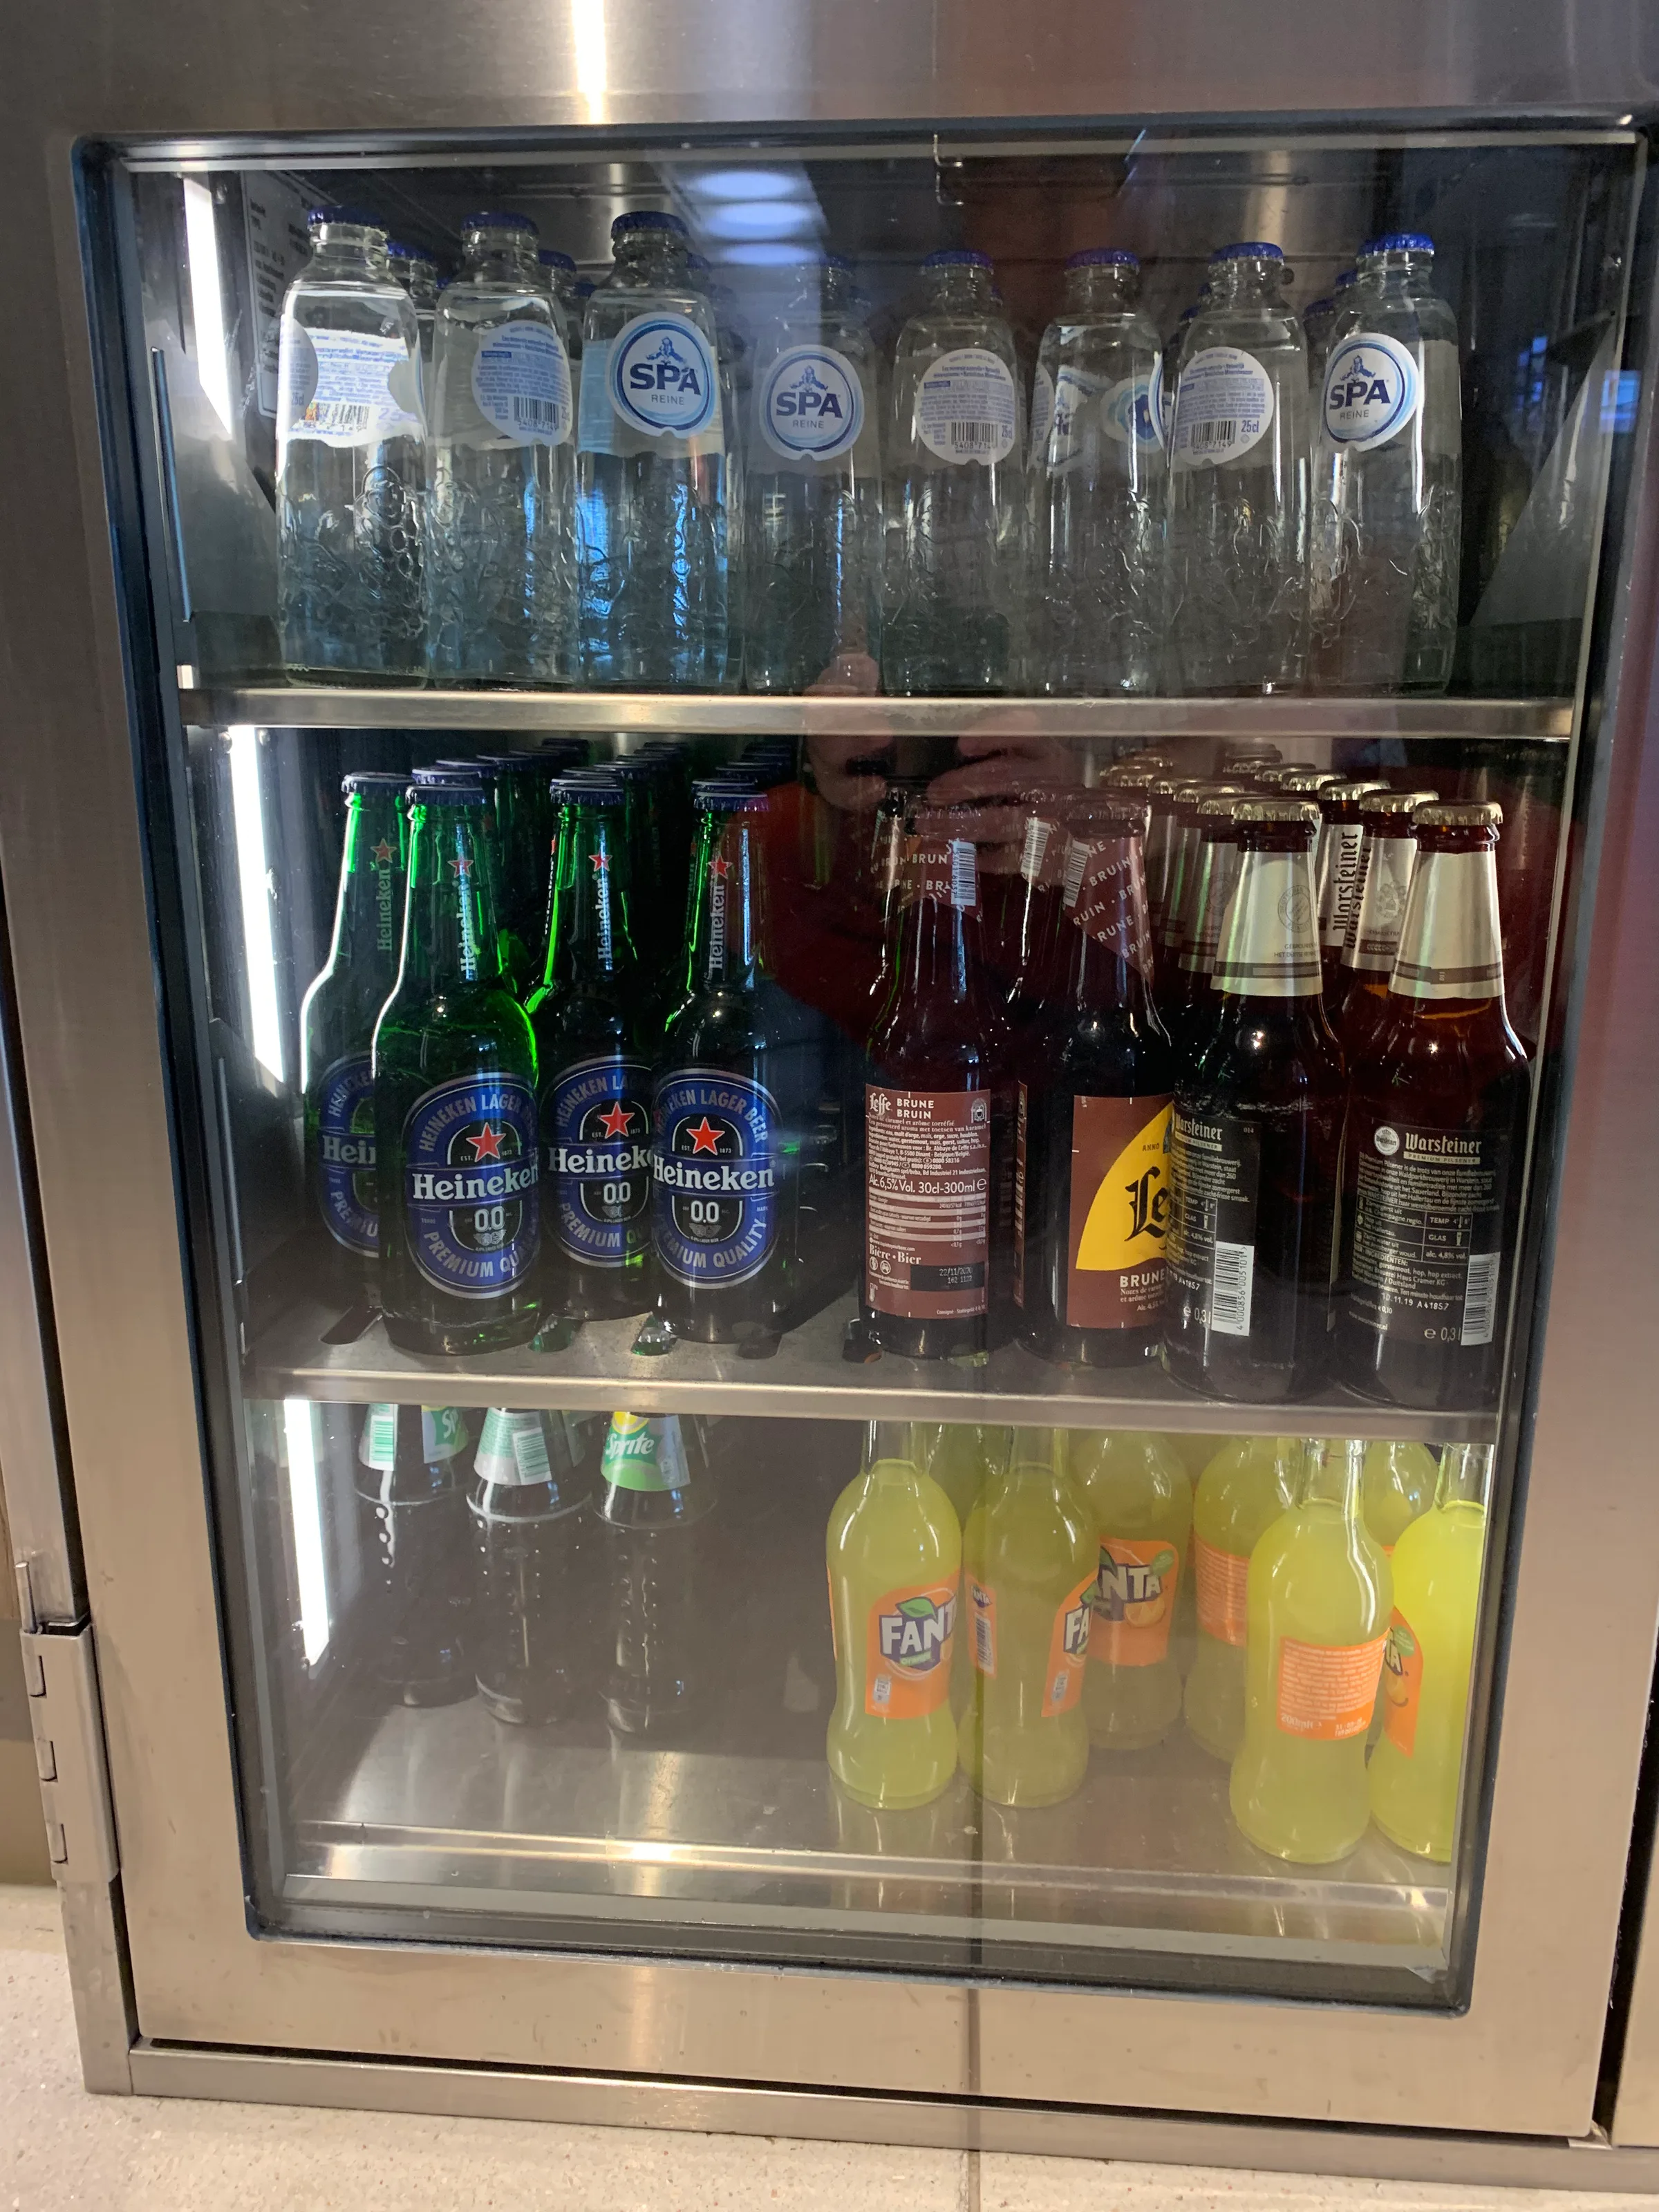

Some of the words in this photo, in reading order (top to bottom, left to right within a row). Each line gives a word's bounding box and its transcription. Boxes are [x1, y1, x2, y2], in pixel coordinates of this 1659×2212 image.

[630, 362, 702, 396] SPA
[651, 394, 684, 405] REINE
[776, 392, 843, 419] SPA
[1329, 379, 1391, 410] SPA
[792, 419, 824, 429] REINE
[1241, 420, 1259, 433] 25cl
[1340, 409, 1369, 421] REINE
[912, 853, 948, 864] BRUN
[1089, 856, 1132, 888] BRUIN
[1333, 832, 1358, 931] Warsteiner
[376, 869, 393, 951] Heineken
[1345, 847, 1371, 949] Warsteiner
[709, 884, 725, 969] Heineken
[1093, 915, 1134, 942] RUNE
[557, 1078, 608, 1127] HEINEKEN
[700, 1089, 747, 1114] LAGER
[745, 1107, 769, 1143] BEER
[869, 1092, 892, 1115] Leffe
[897, 1098, 935, 1109] BRUNE
[897, 1109, 932, 1119] BRUIN
[419, 1095, 476, 1152] HEINEKEN
[1143, 1143, 1160, 1152] ANNO
[1405, 1132, 1482, 1154] Warsteiner
[1408, 1154, 1440, 1162] PREMIUM
[412, 1161, 539, 1201] Heineken
[653, 1154, 776, 1191] Heineken
[561, 1201, 621, 1248] PREMIUM
[691, 1200, 720, 1224] 0.0
[713, 1217, 767, 1268] QUALITY
[1428, 1234, 1447, 1242] GLAS
[424, 1230, 494, 1278] PREMIUM
[869, 1244, 891, 1261] Bière
[897, 1251, 921, 1264] Bier
[1120, 1268, 1165, 1287] BRUNE
[606, 1431, 655, 1456] Sprite
[1102, 1565, 1161, 1602] NTA
[881, 1596, 957, 1655] FANT
